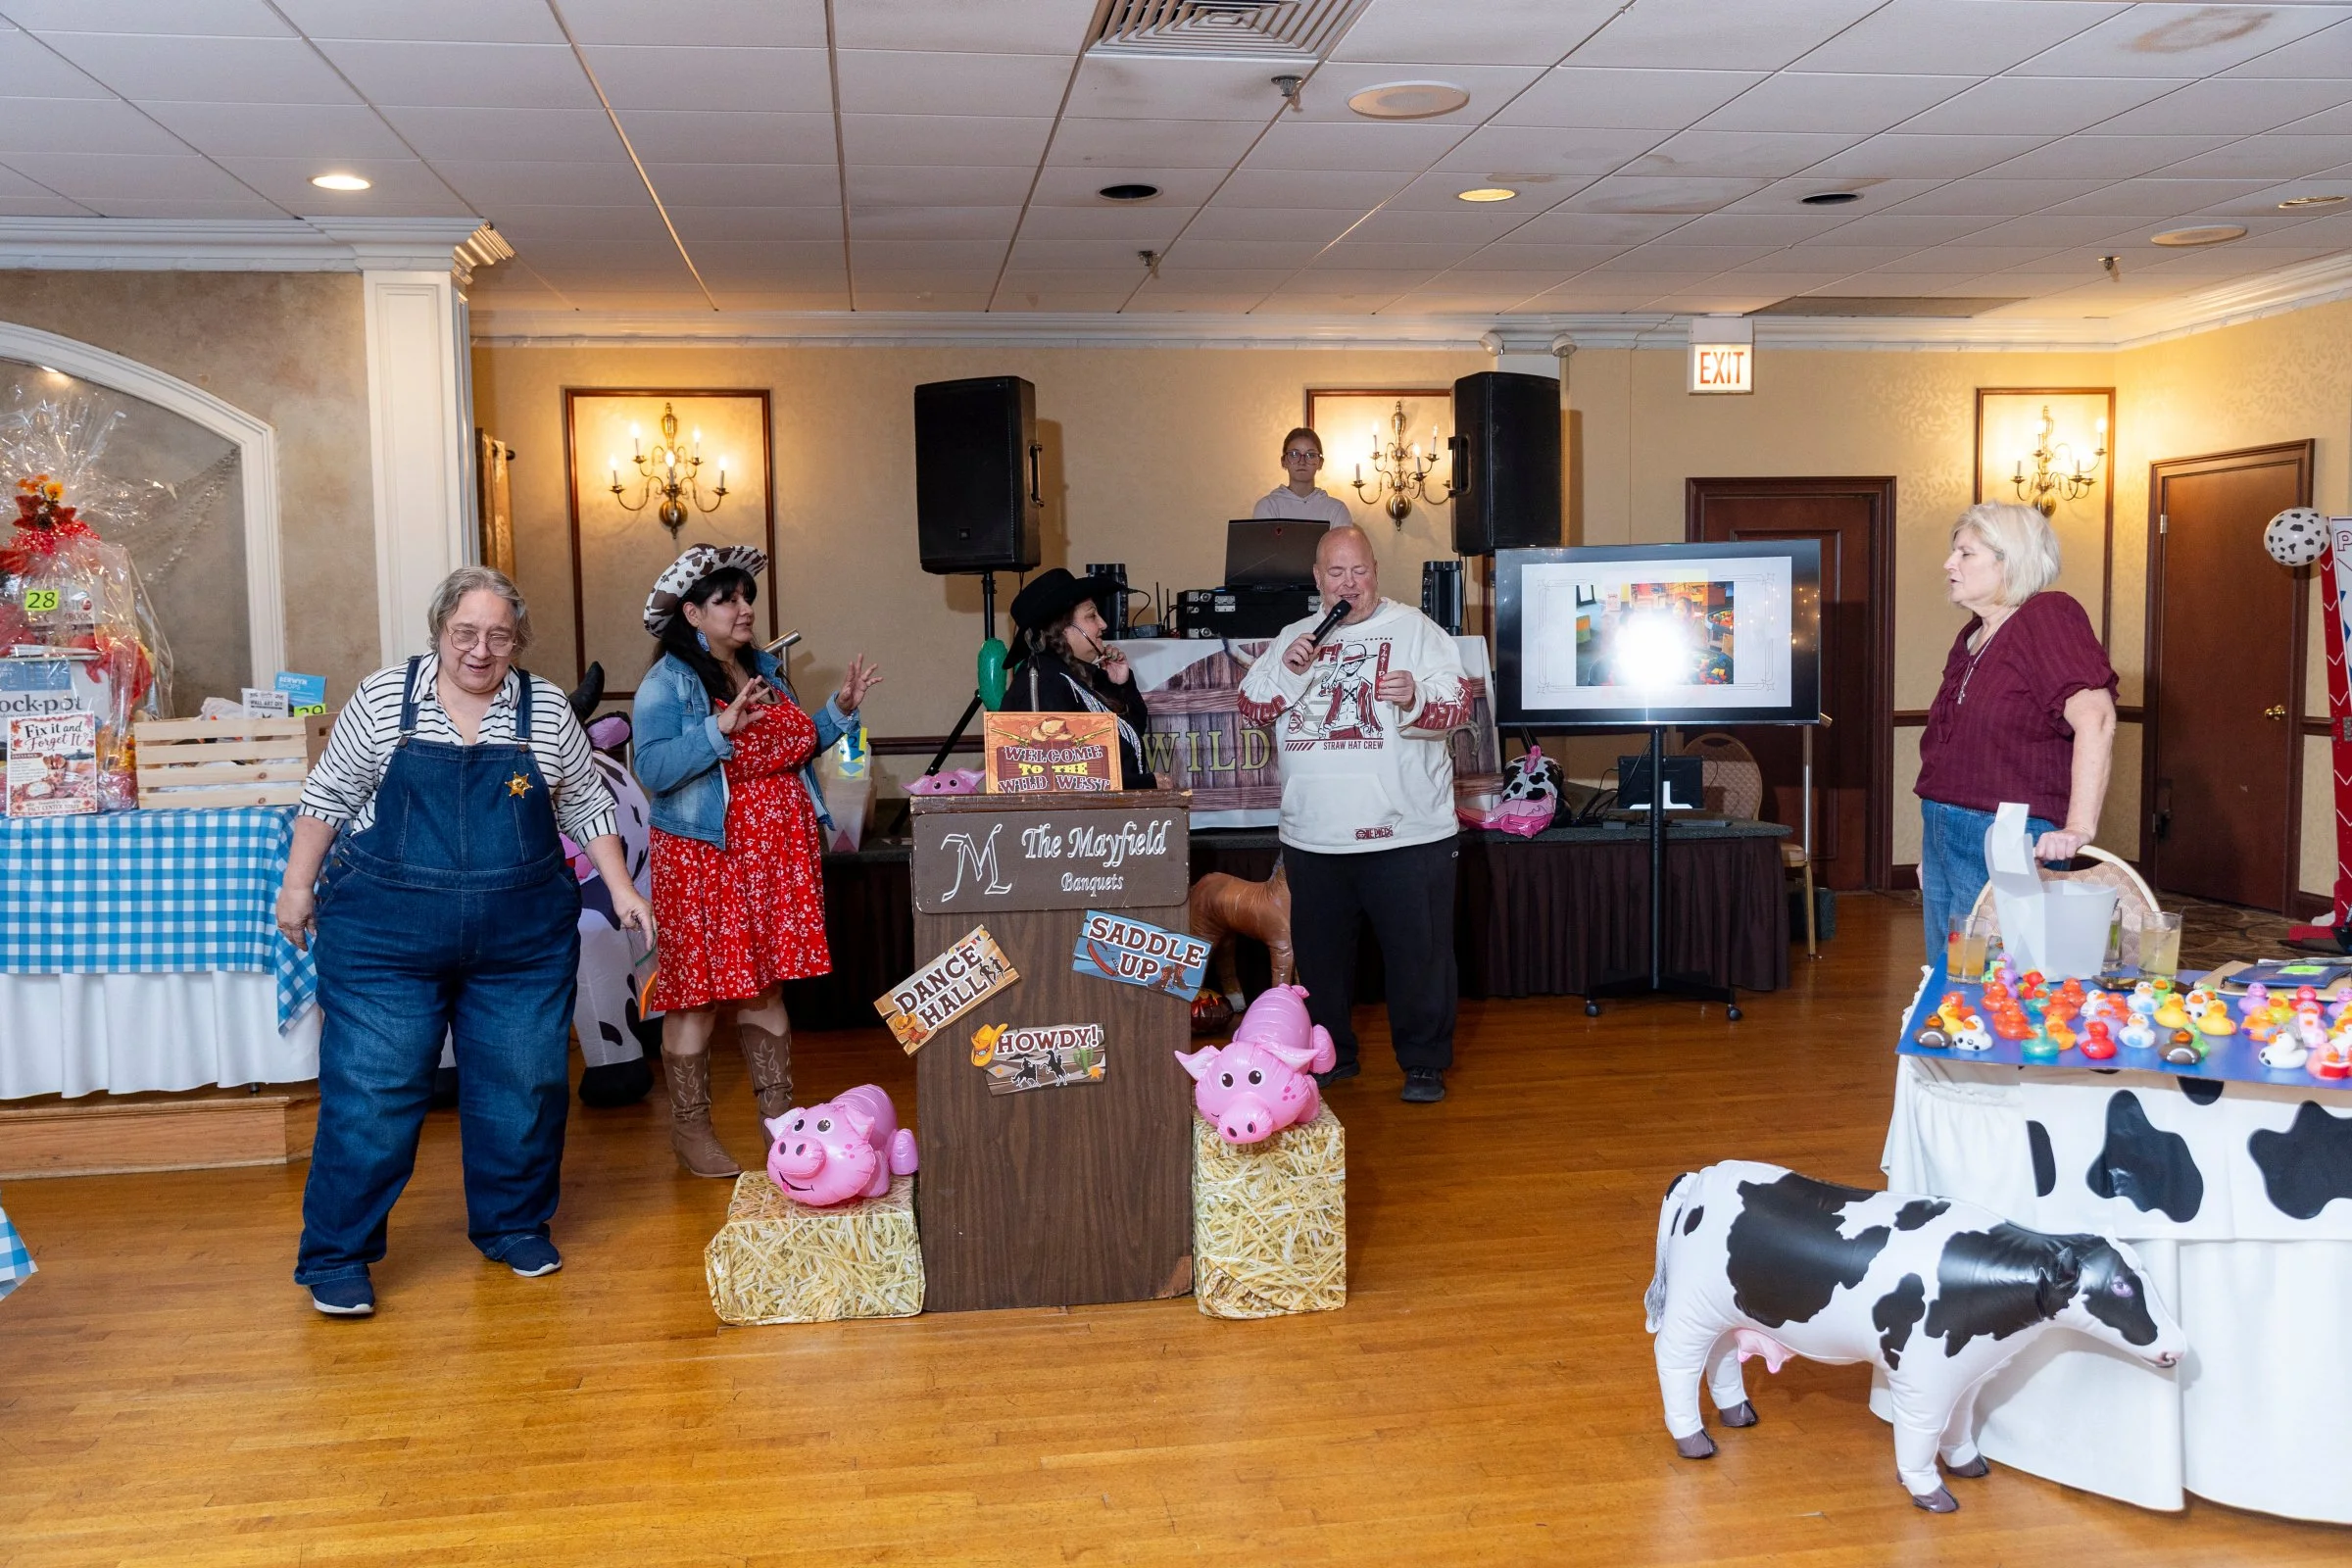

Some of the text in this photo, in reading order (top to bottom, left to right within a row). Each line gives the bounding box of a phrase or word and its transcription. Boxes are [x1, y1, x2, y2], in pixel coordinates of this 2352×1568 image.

[1699, 351, 1744, 384] EXIT
[27, 592, 56, 609] 28
[24, 721, 82, 738] Fix it and
[24, 733, 68, 752] Forget
[1004, 745, 1103, 763] WELCOME
[1141, 728, 1272, 773] WILD
[1323, 740, 1384, 751] STRAW HAT CREW
[1018, 761, 1089, 776] TO THE
[998, 774, 1111, 794] WILD WEST
[1021, 820, 1172, 868] The Mayfield
[1060, 872, 1124, 898] Banquets
[1089, 916, 1206, 967] SADDLE
[894, 945, 984, 1015] DANCE
[1119, 952, 1159, 981] UP
[918, 975, 989, 1029] HALL
[996, 1024, 1099, 1054] HOWDY!
